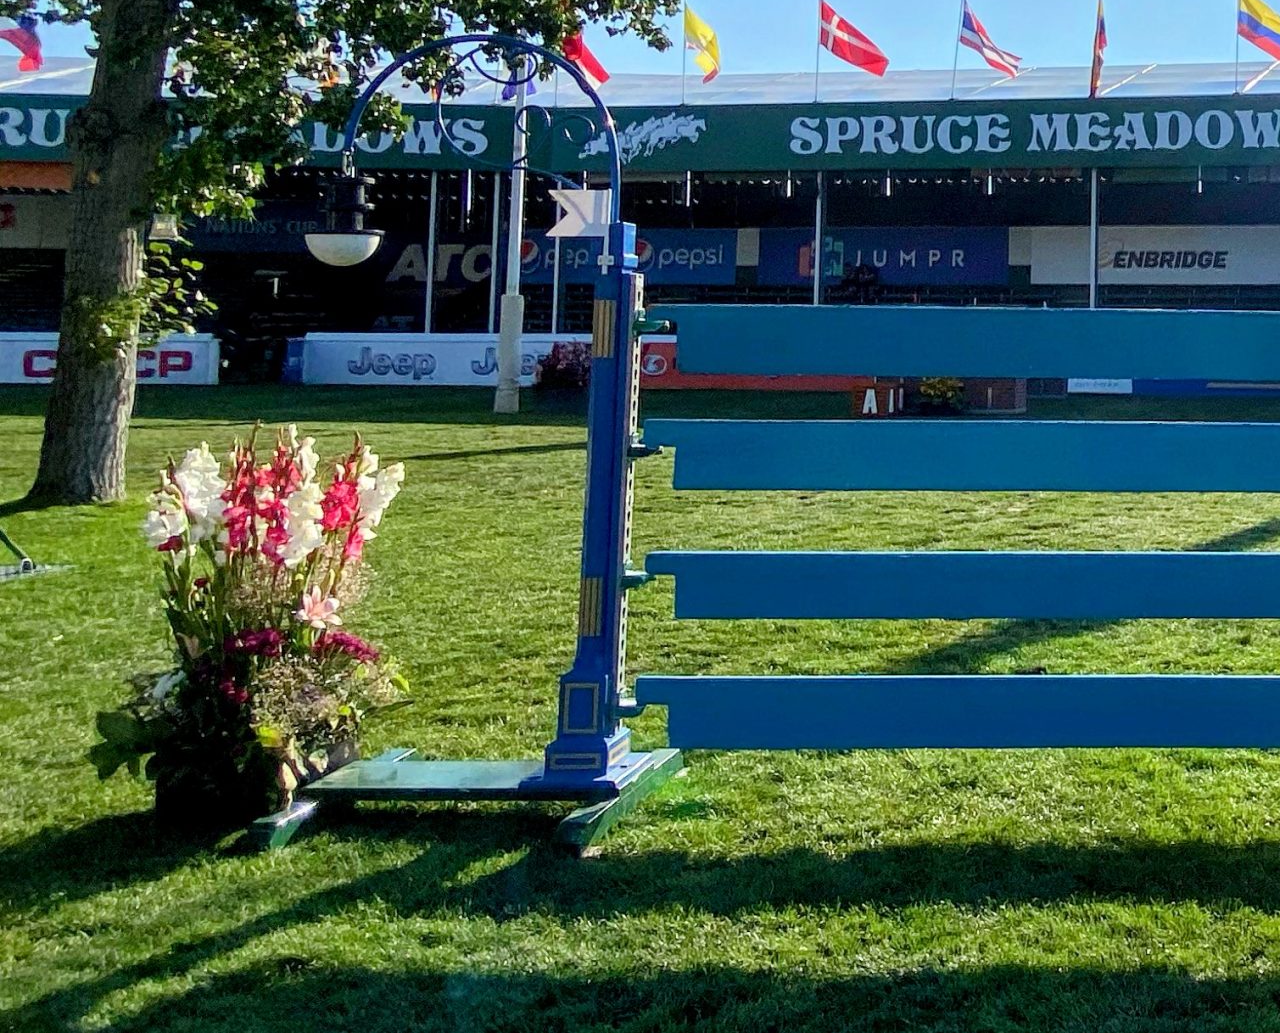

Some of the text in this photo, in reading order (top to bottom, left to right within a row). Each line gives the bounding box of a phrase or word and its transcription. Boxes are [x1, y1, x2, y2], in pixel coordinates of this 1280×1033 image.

[0, 107, 70, 147] RU
[790, 113, 1012, 155] SPRUCE
[385, 244, 493, 283] ATC
[544, 248, 590, 270] pep
[658, 244, 724, 270] pepsi
[855, 249, 965, 268] JUMPR
[1113, 250, 1229, 269] ENBRIDGE
[23, 349, 58, 379] C
[347, 346, 438, 380] Jeep
[471, 347, 553, 376] Je
[862, 388, 878, 414] A
